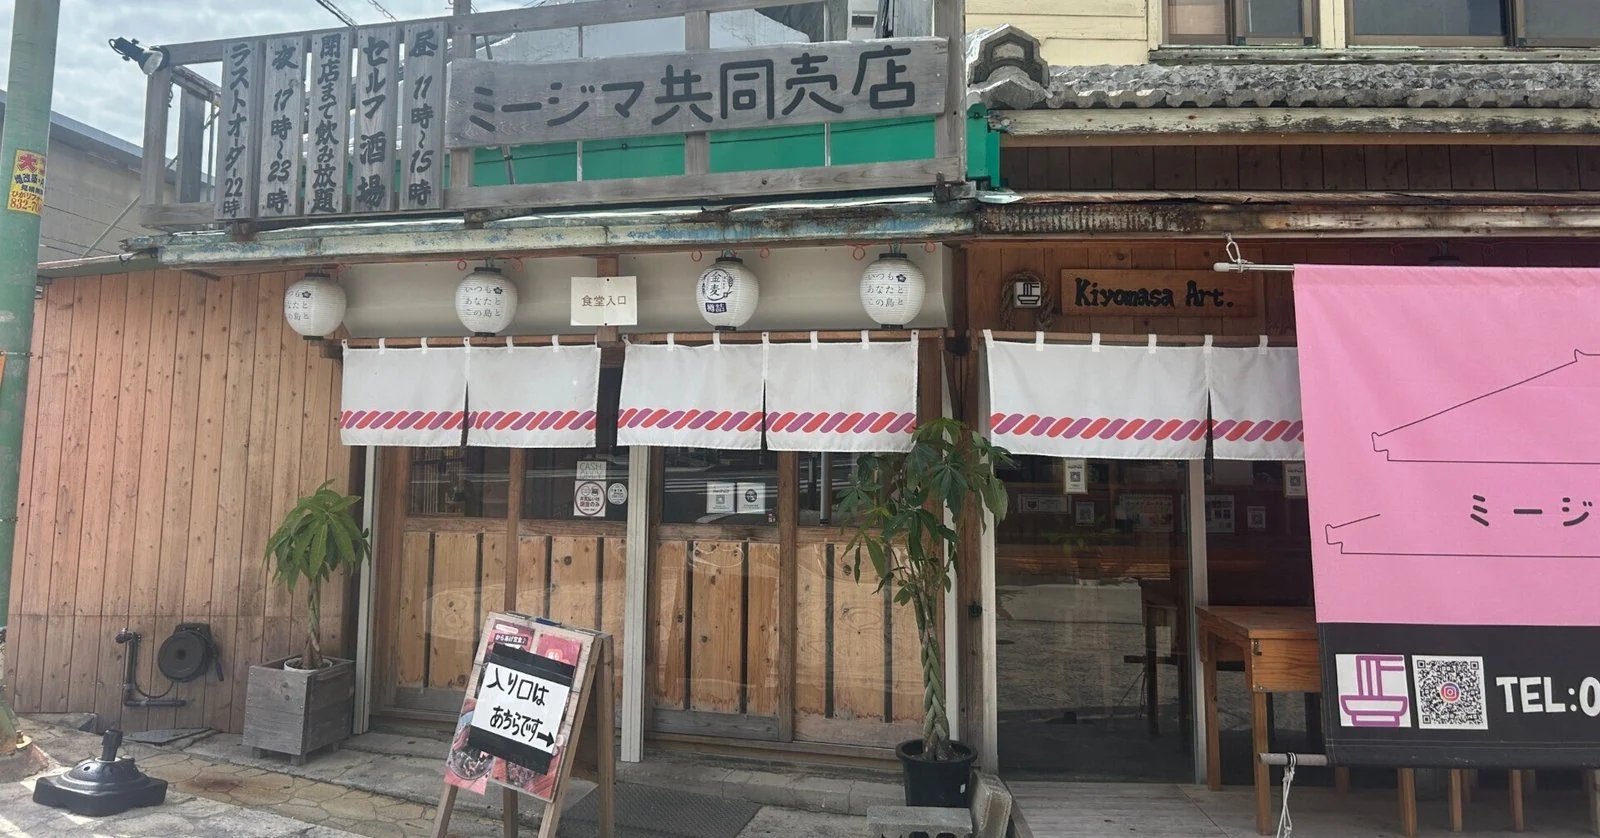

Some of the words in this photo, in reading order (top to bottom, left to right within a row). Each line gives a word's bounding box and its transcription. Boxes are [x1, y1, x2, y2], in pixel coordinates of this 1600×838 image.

[409, 29, 438, 57] 昼
[272, 45, 299, 71] 夜
[469, 45, 916, 131] ミージマ共同売店
[311, 33, 341, 213] 閉店まで飲み放題
[710, 271, 722, 297] 金麦
[866, 285, 904, 294] あなたと
[1075, 278, 1174, 307] Kiyomasa
[1186, 280, 1234, 307] Art.
[581, 295, 627, 307] 食堂入口
[867, 298, 904, 307] この島と
[579, 462, 602, 471] CASH
[1470, 493, 1593, 527] ミージ
[486, 667, 549, 707] 入り口は
[489, 705, 543, 743] あちらです
